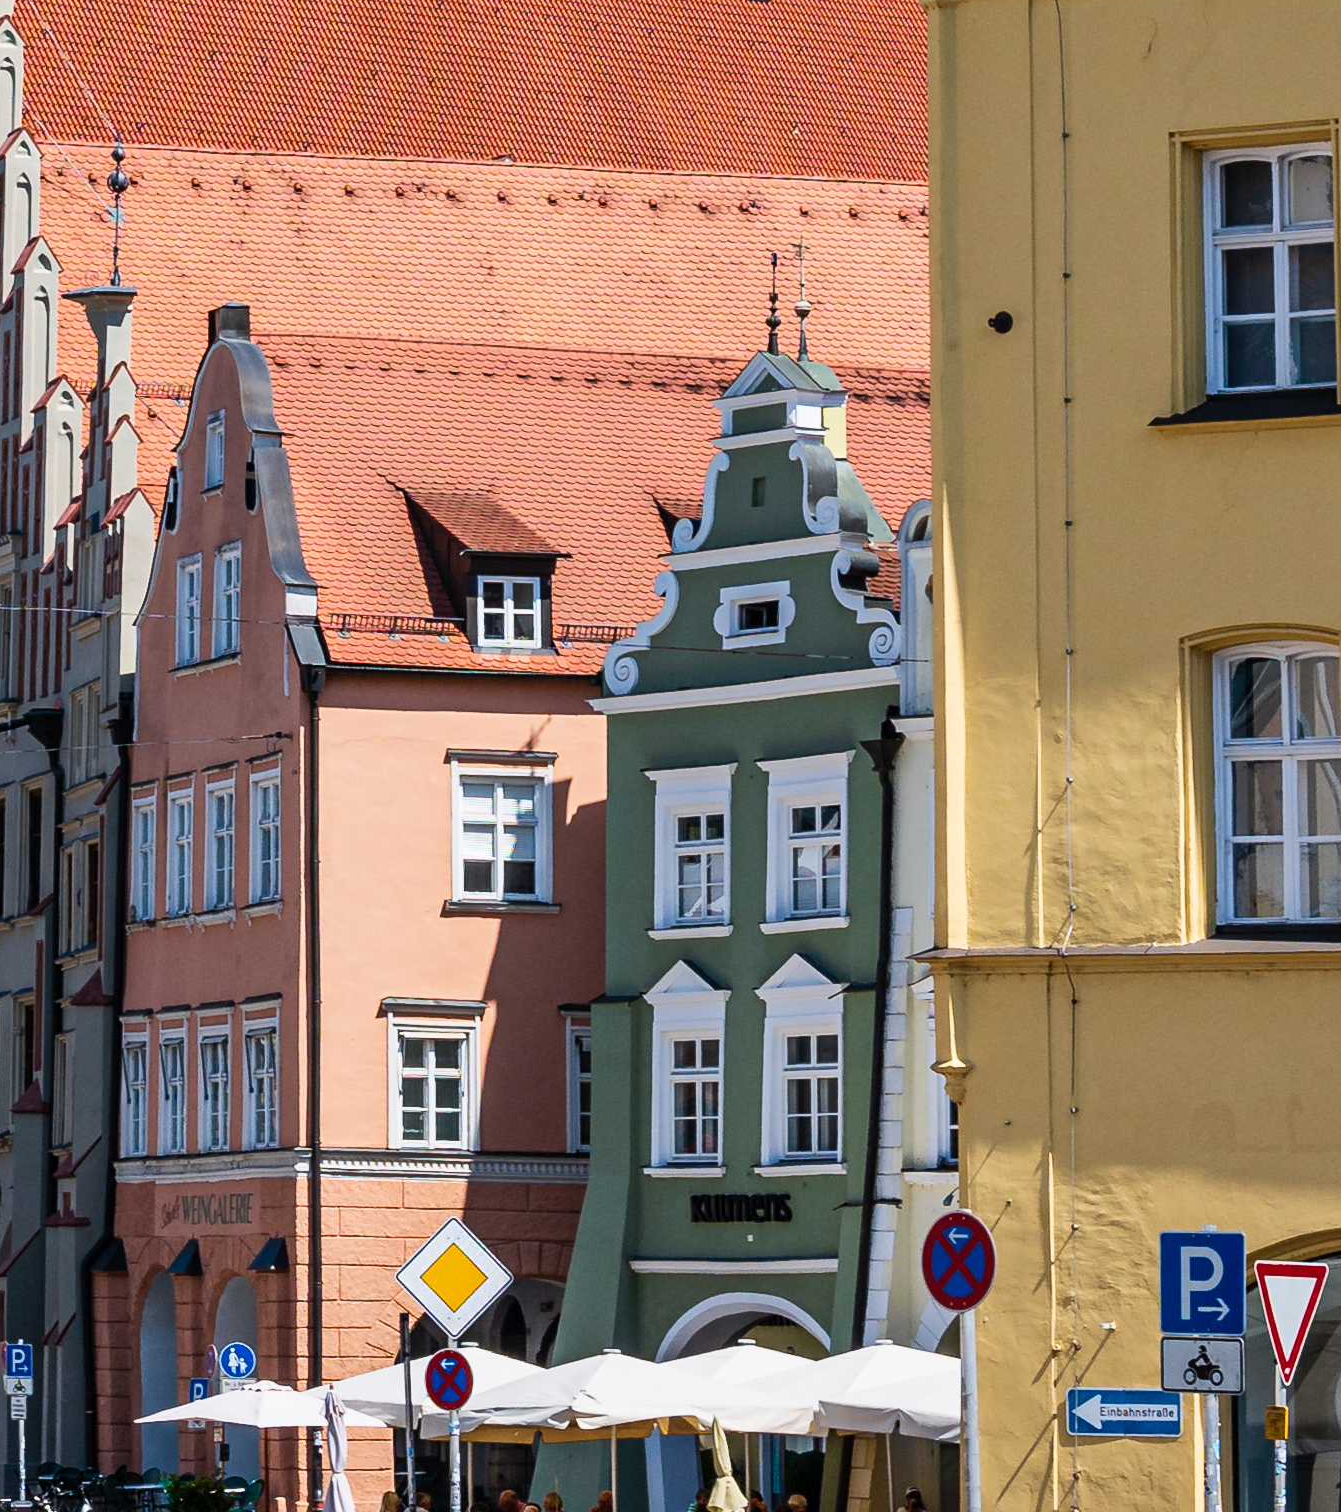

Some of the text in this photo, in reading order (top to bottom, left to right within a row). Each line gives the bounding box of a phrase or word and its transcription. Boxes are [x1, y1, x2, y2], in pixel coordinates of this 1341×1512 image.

[182, 1193, 254, 1225] WEINGALERIE
[1181, 1246, 1224, 1320] P
[12, 1349, 26, 1373] P
[1100, 1406, 1174, 1418] Einbahnstraße
